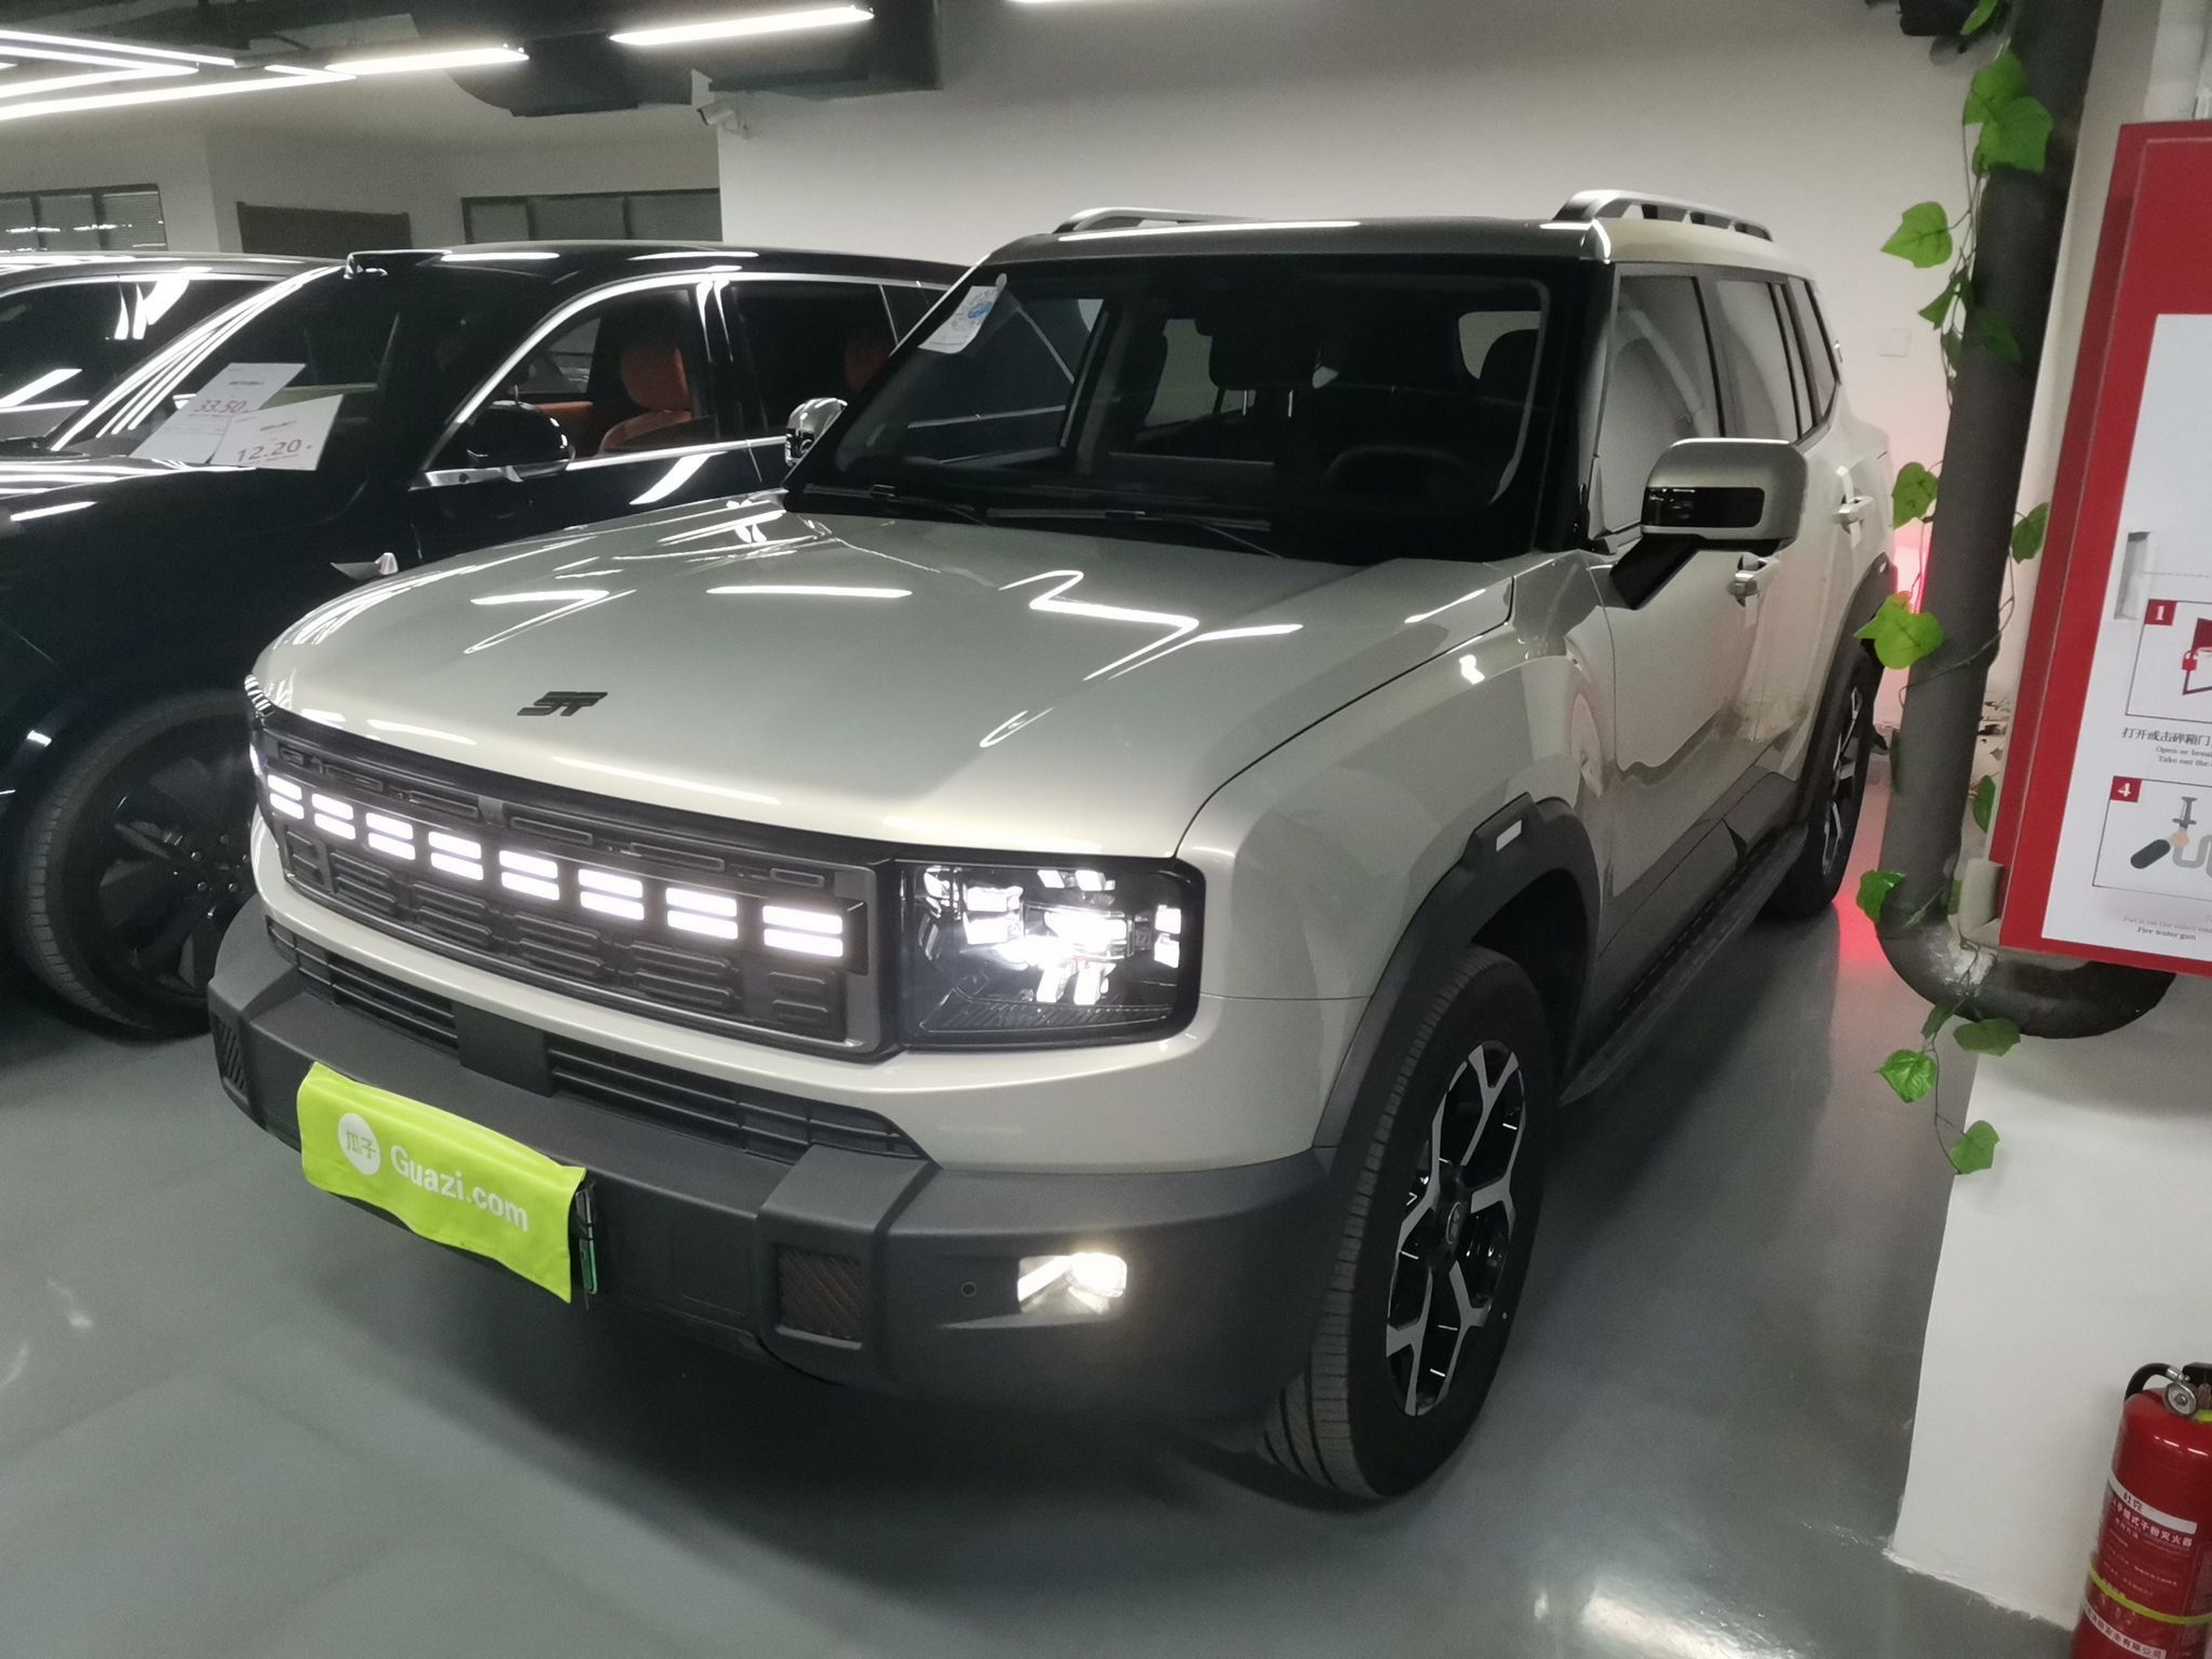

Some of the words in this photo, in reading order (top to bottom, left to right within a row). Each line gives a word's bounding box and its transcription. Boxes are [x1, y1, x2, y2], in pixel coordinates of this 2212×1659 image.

[238, 438, 302, 462] 12.20
[2156, 605, 2164, 620] 1
[2159, 756, 2178, 764] Take
[2118, 782, 2131, 797] 4
[346, 1131, 377, 1160] 瓜子
[390, 1145, 528, 1233] Guazi.com
